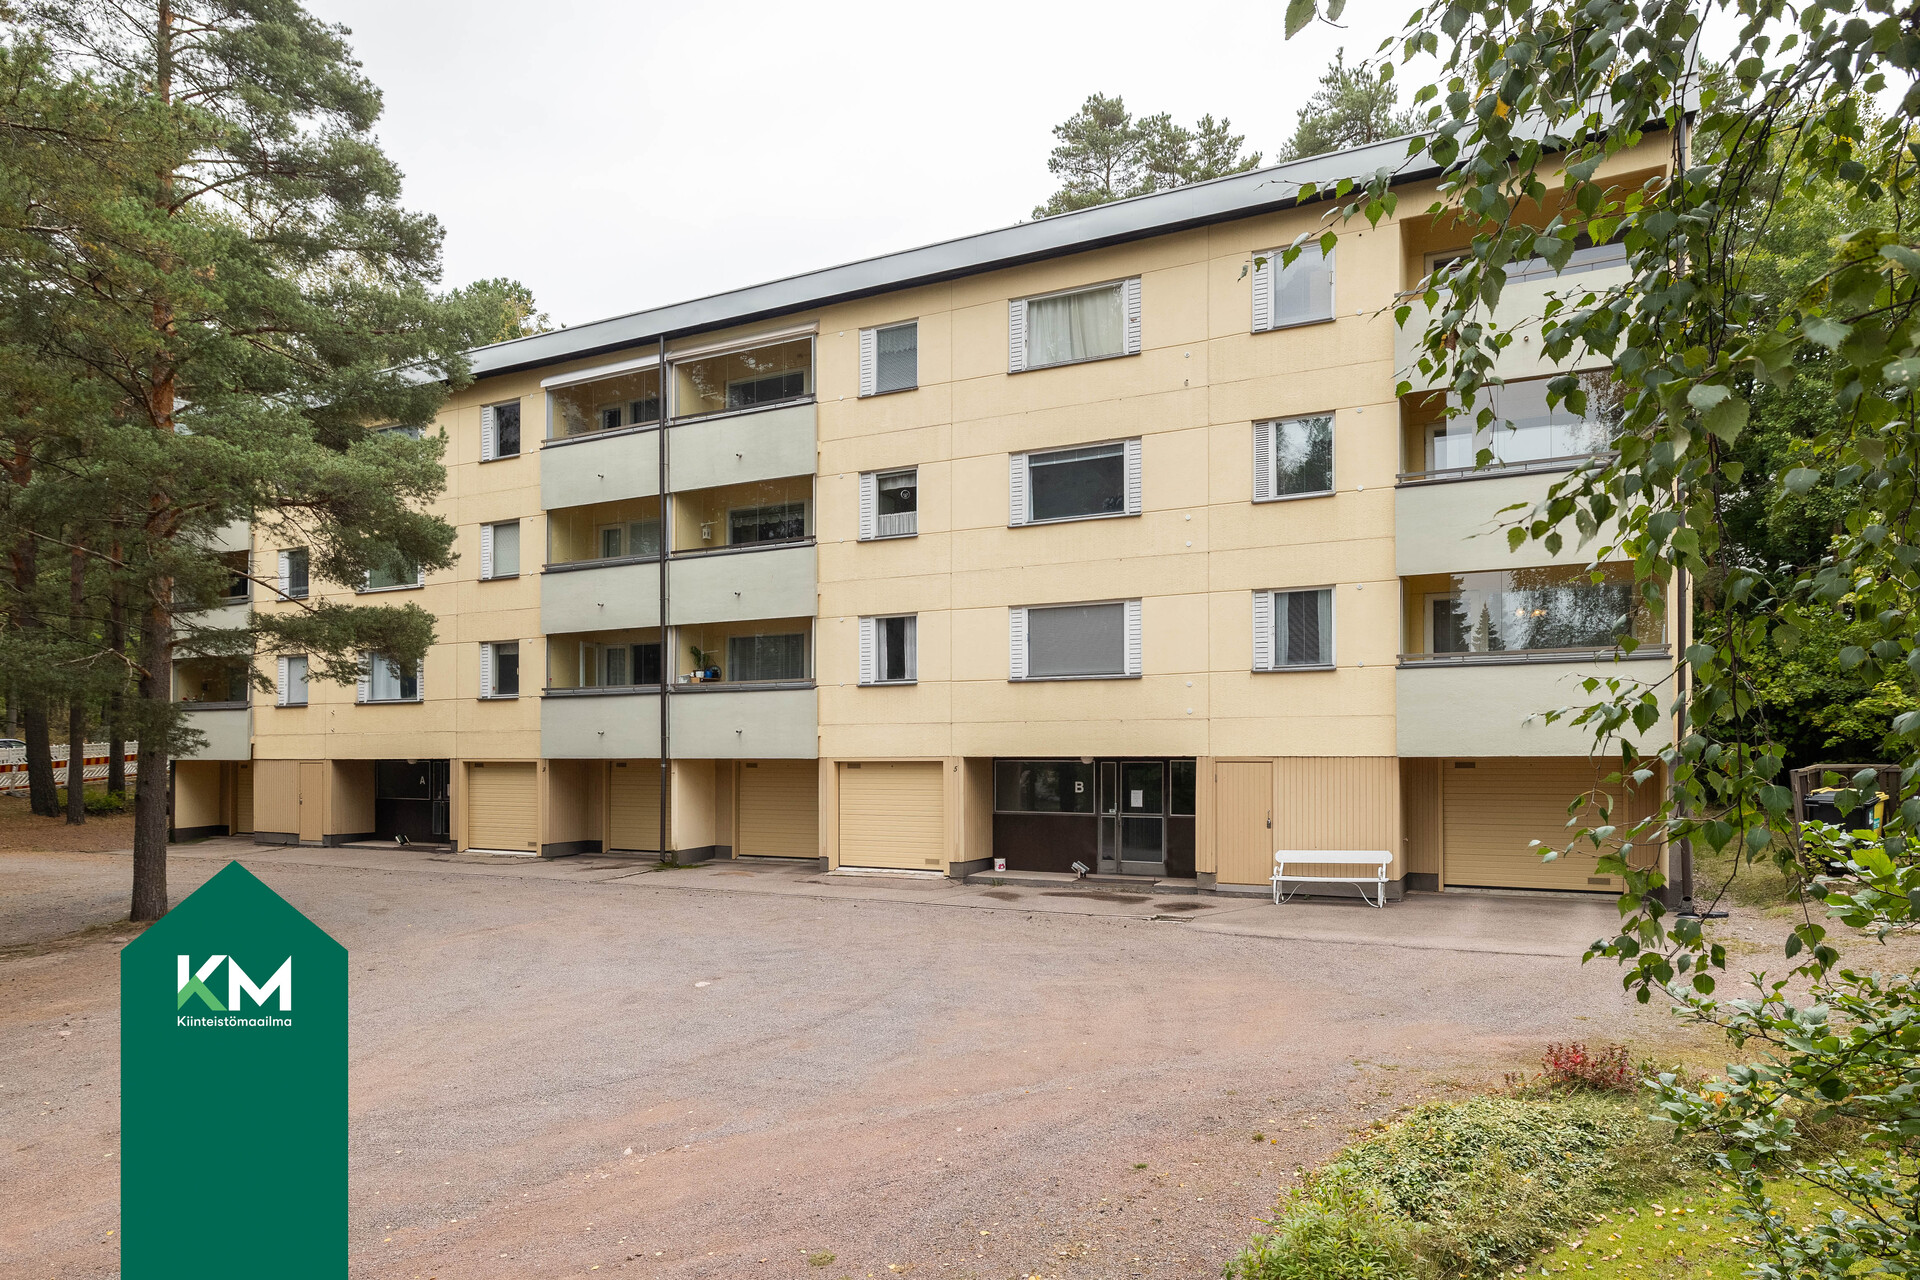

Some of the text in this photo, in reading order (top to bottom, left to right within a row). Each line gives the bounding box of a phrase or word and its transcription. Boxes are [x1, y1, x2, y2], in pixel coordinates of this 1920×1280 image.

[953, 765, 958, 773] 5
[419, 775, 426, 785] A
[1074, 781, 1085, 793] B
